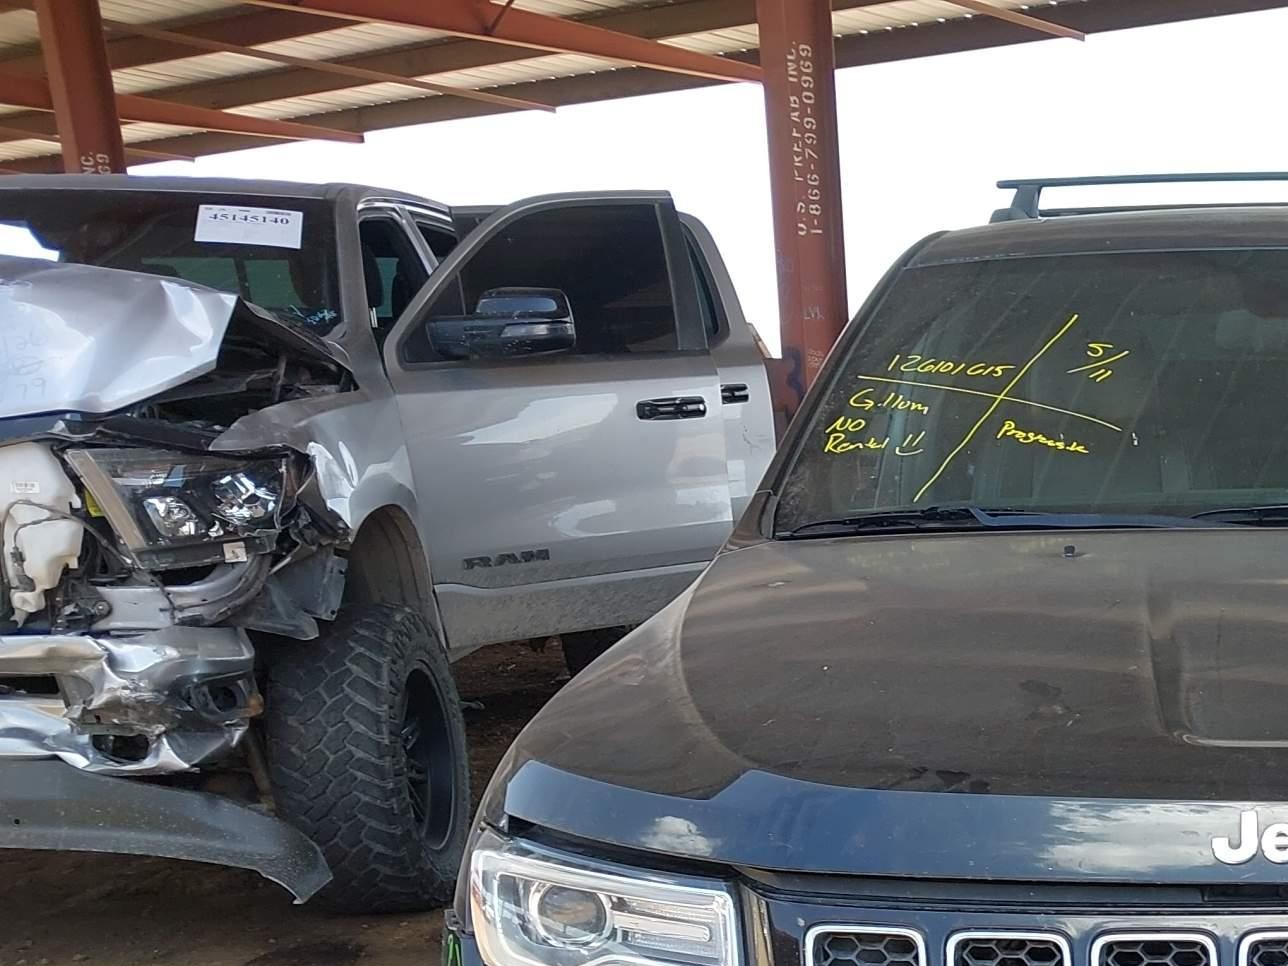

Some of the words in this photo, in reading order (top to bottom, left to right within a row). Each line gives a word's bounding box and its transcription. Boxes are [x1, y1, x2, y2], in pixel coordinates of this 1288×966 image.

[799, 44, 823, 236] 1-866-799-0969
[208, 213, 290, 225] 45145140
[463, 549, 550, 570] RAM
